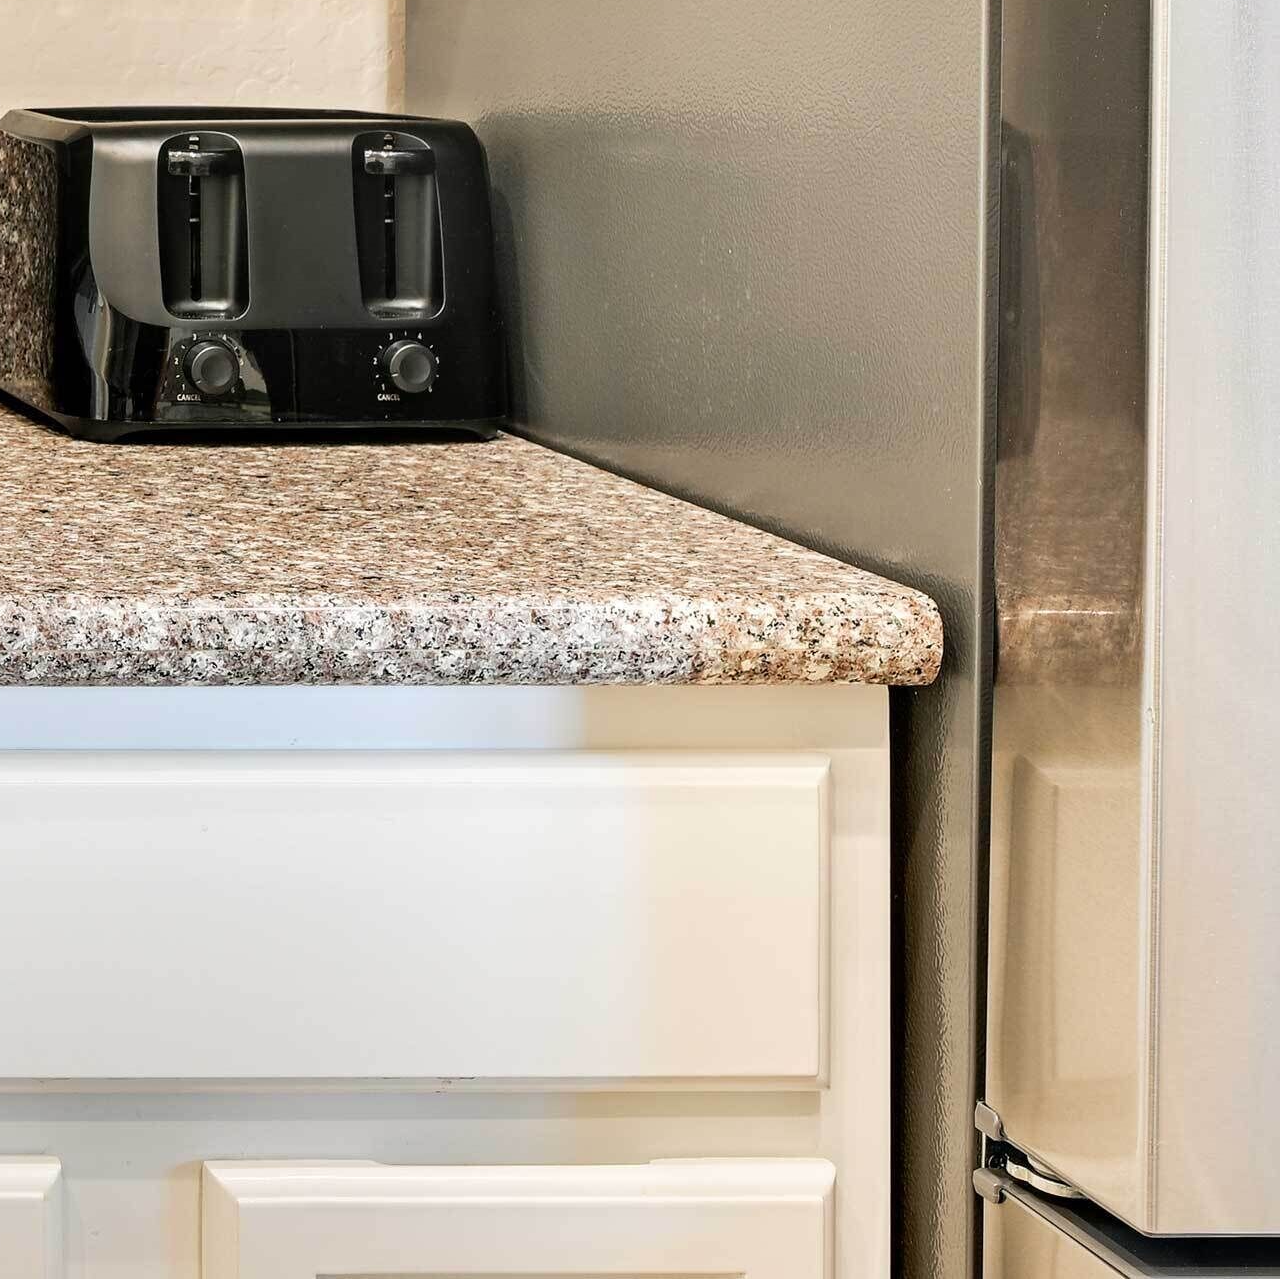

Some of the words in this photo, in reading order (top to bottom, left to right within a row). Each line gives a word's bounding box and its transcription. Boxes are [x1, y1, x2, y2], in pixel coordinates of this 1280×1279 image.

[174, 357, 179, 365] 2
[373, 357, 378, 365] 2
[377, 393, 400, 401] CANCEL
